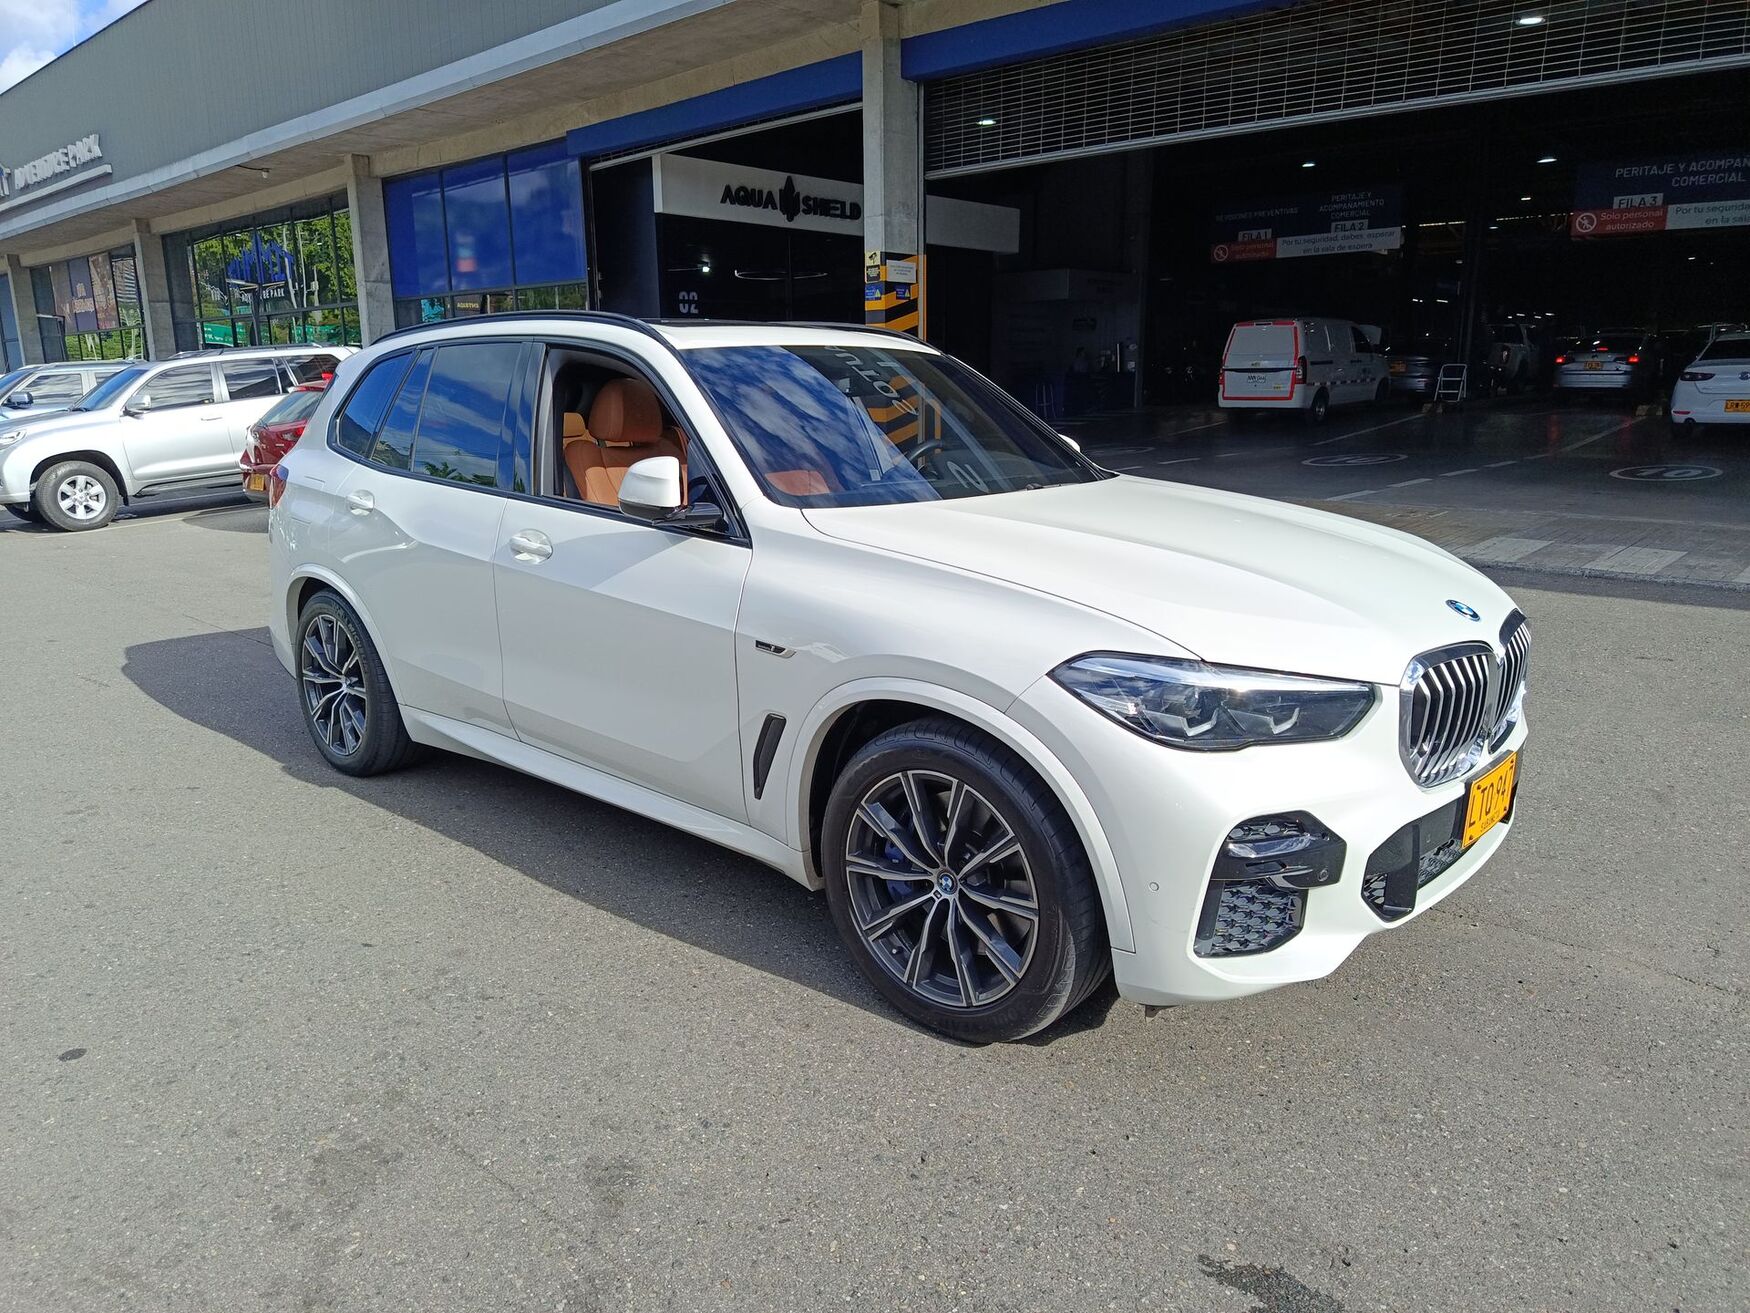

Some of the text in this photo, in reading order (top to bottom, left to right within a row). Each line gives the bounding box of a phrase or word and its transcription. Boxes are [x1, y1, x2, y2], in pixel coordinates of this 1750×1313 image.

[1615, 163, 1675, 178] PERITAJE
[1678, 163, 1686, 173] Y
[1671, 172, 1746, 187] COMERCIAL
[720, 184, 862, 221] AQUA SHIELD
[1618, 195, 1658, 208] FILA 3
[1600, 209, 1664, 221] Solo personal
[1675, 206, 1692, 215] Por
[1694, 206, 1704, 214] tu
[1334, 222, 1354, 233] FILA
[1606, 221, 1655, 232] autorizado
[678, 291, 699, 314] 02
